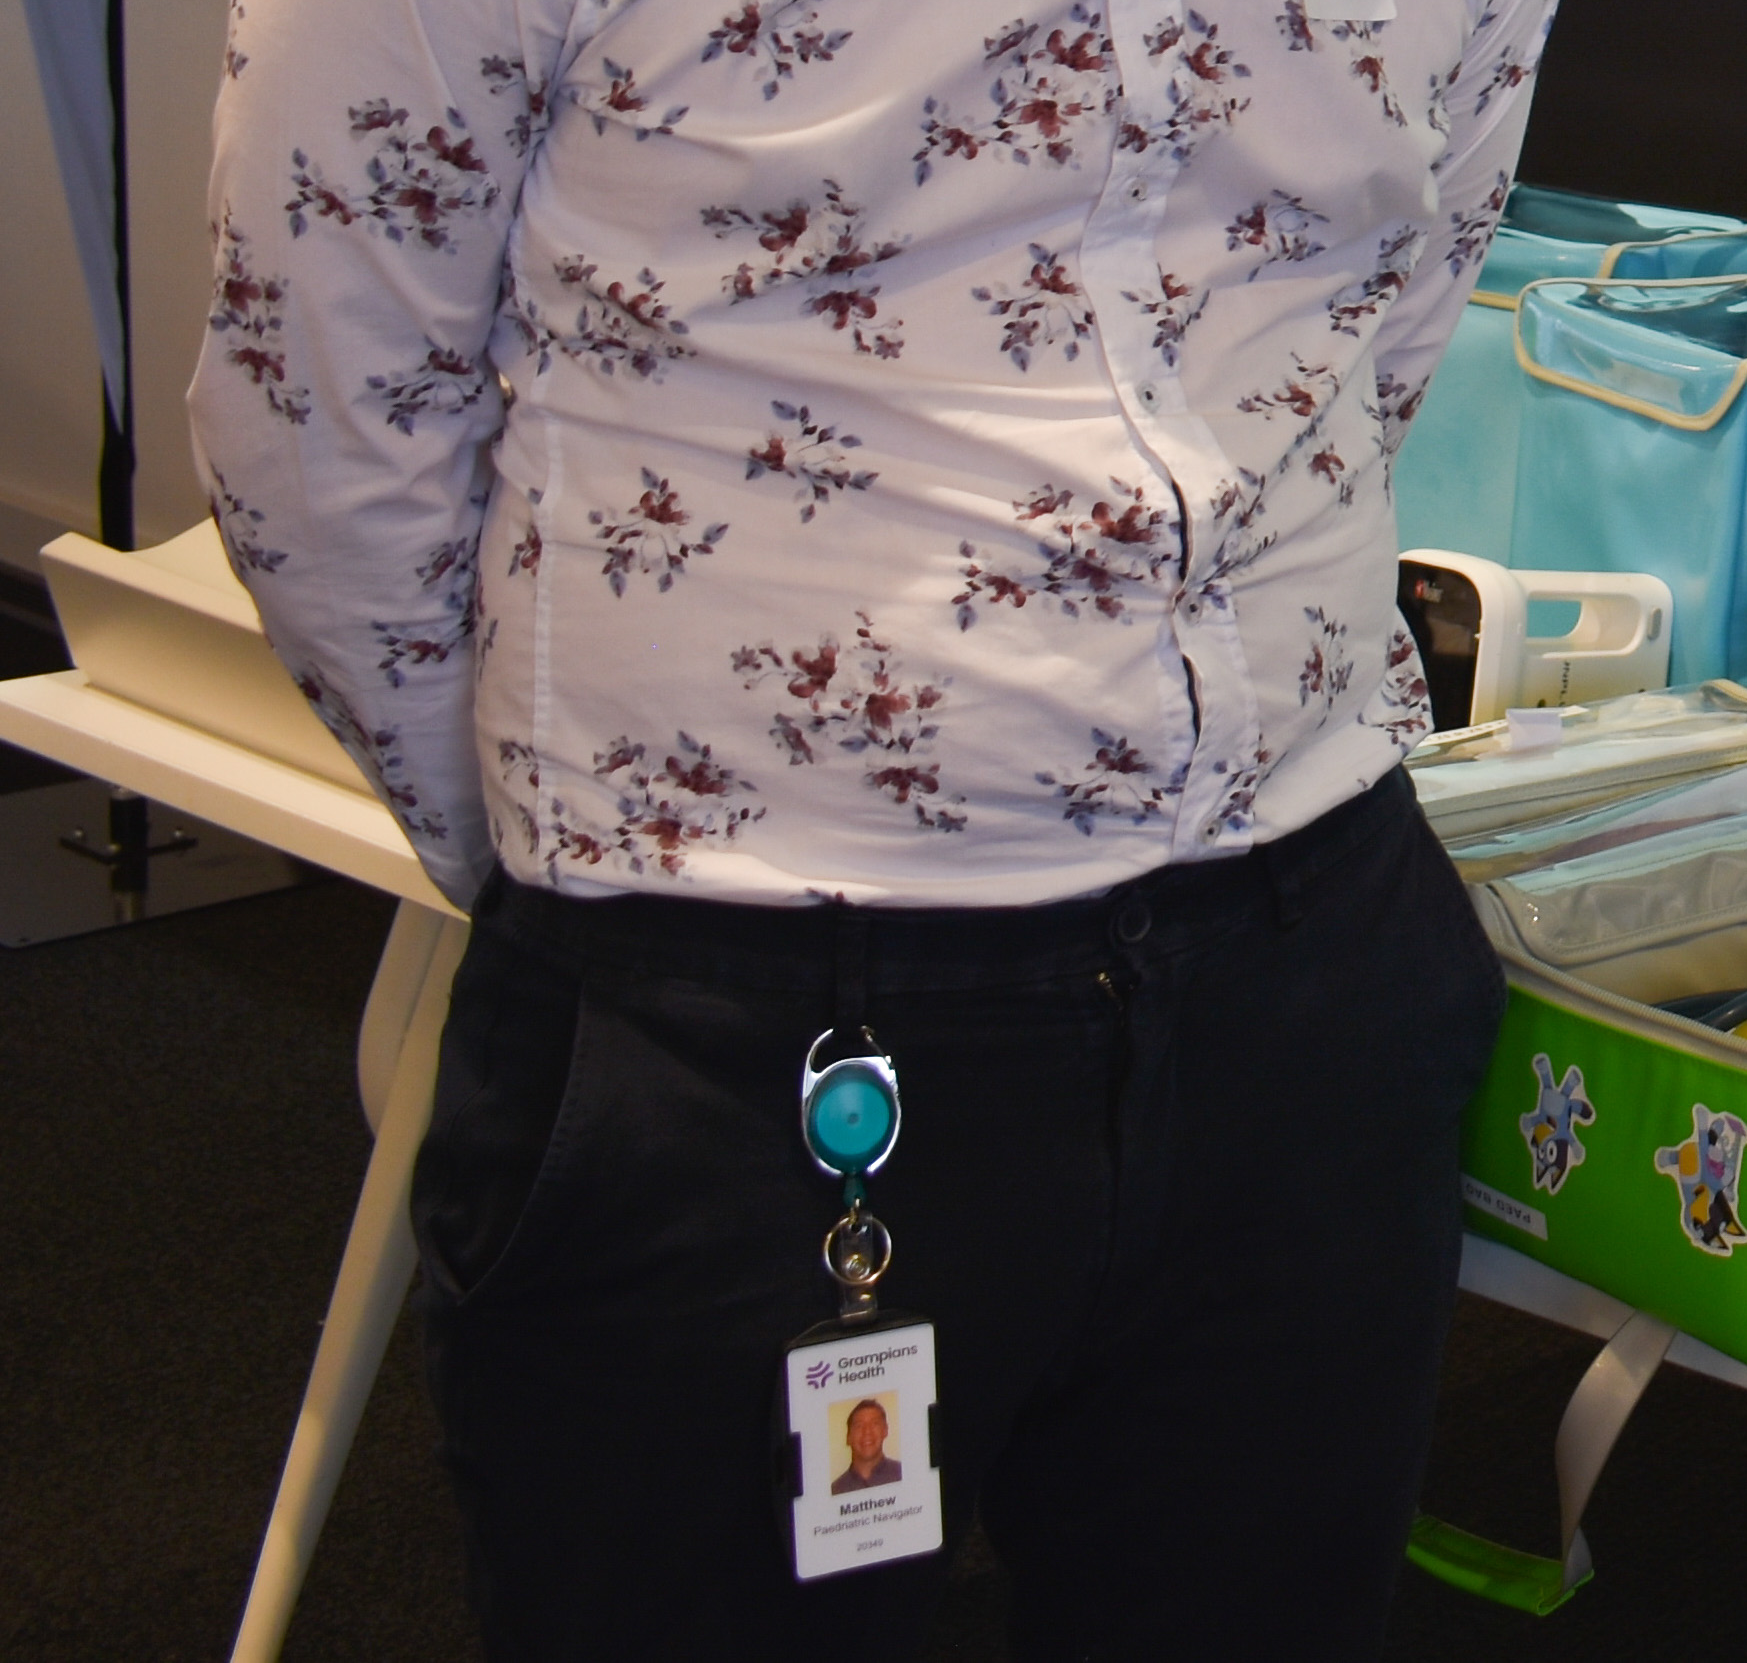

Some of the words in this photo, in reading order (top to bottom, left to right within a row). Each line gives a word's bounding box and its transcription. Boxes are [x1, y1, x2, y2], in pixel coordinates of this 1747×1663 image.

[838, 1345, 919, 1369] Grampians
[838, 1365, 885, 1385] Health
[840, 1495, 897, 1516] Matthew
